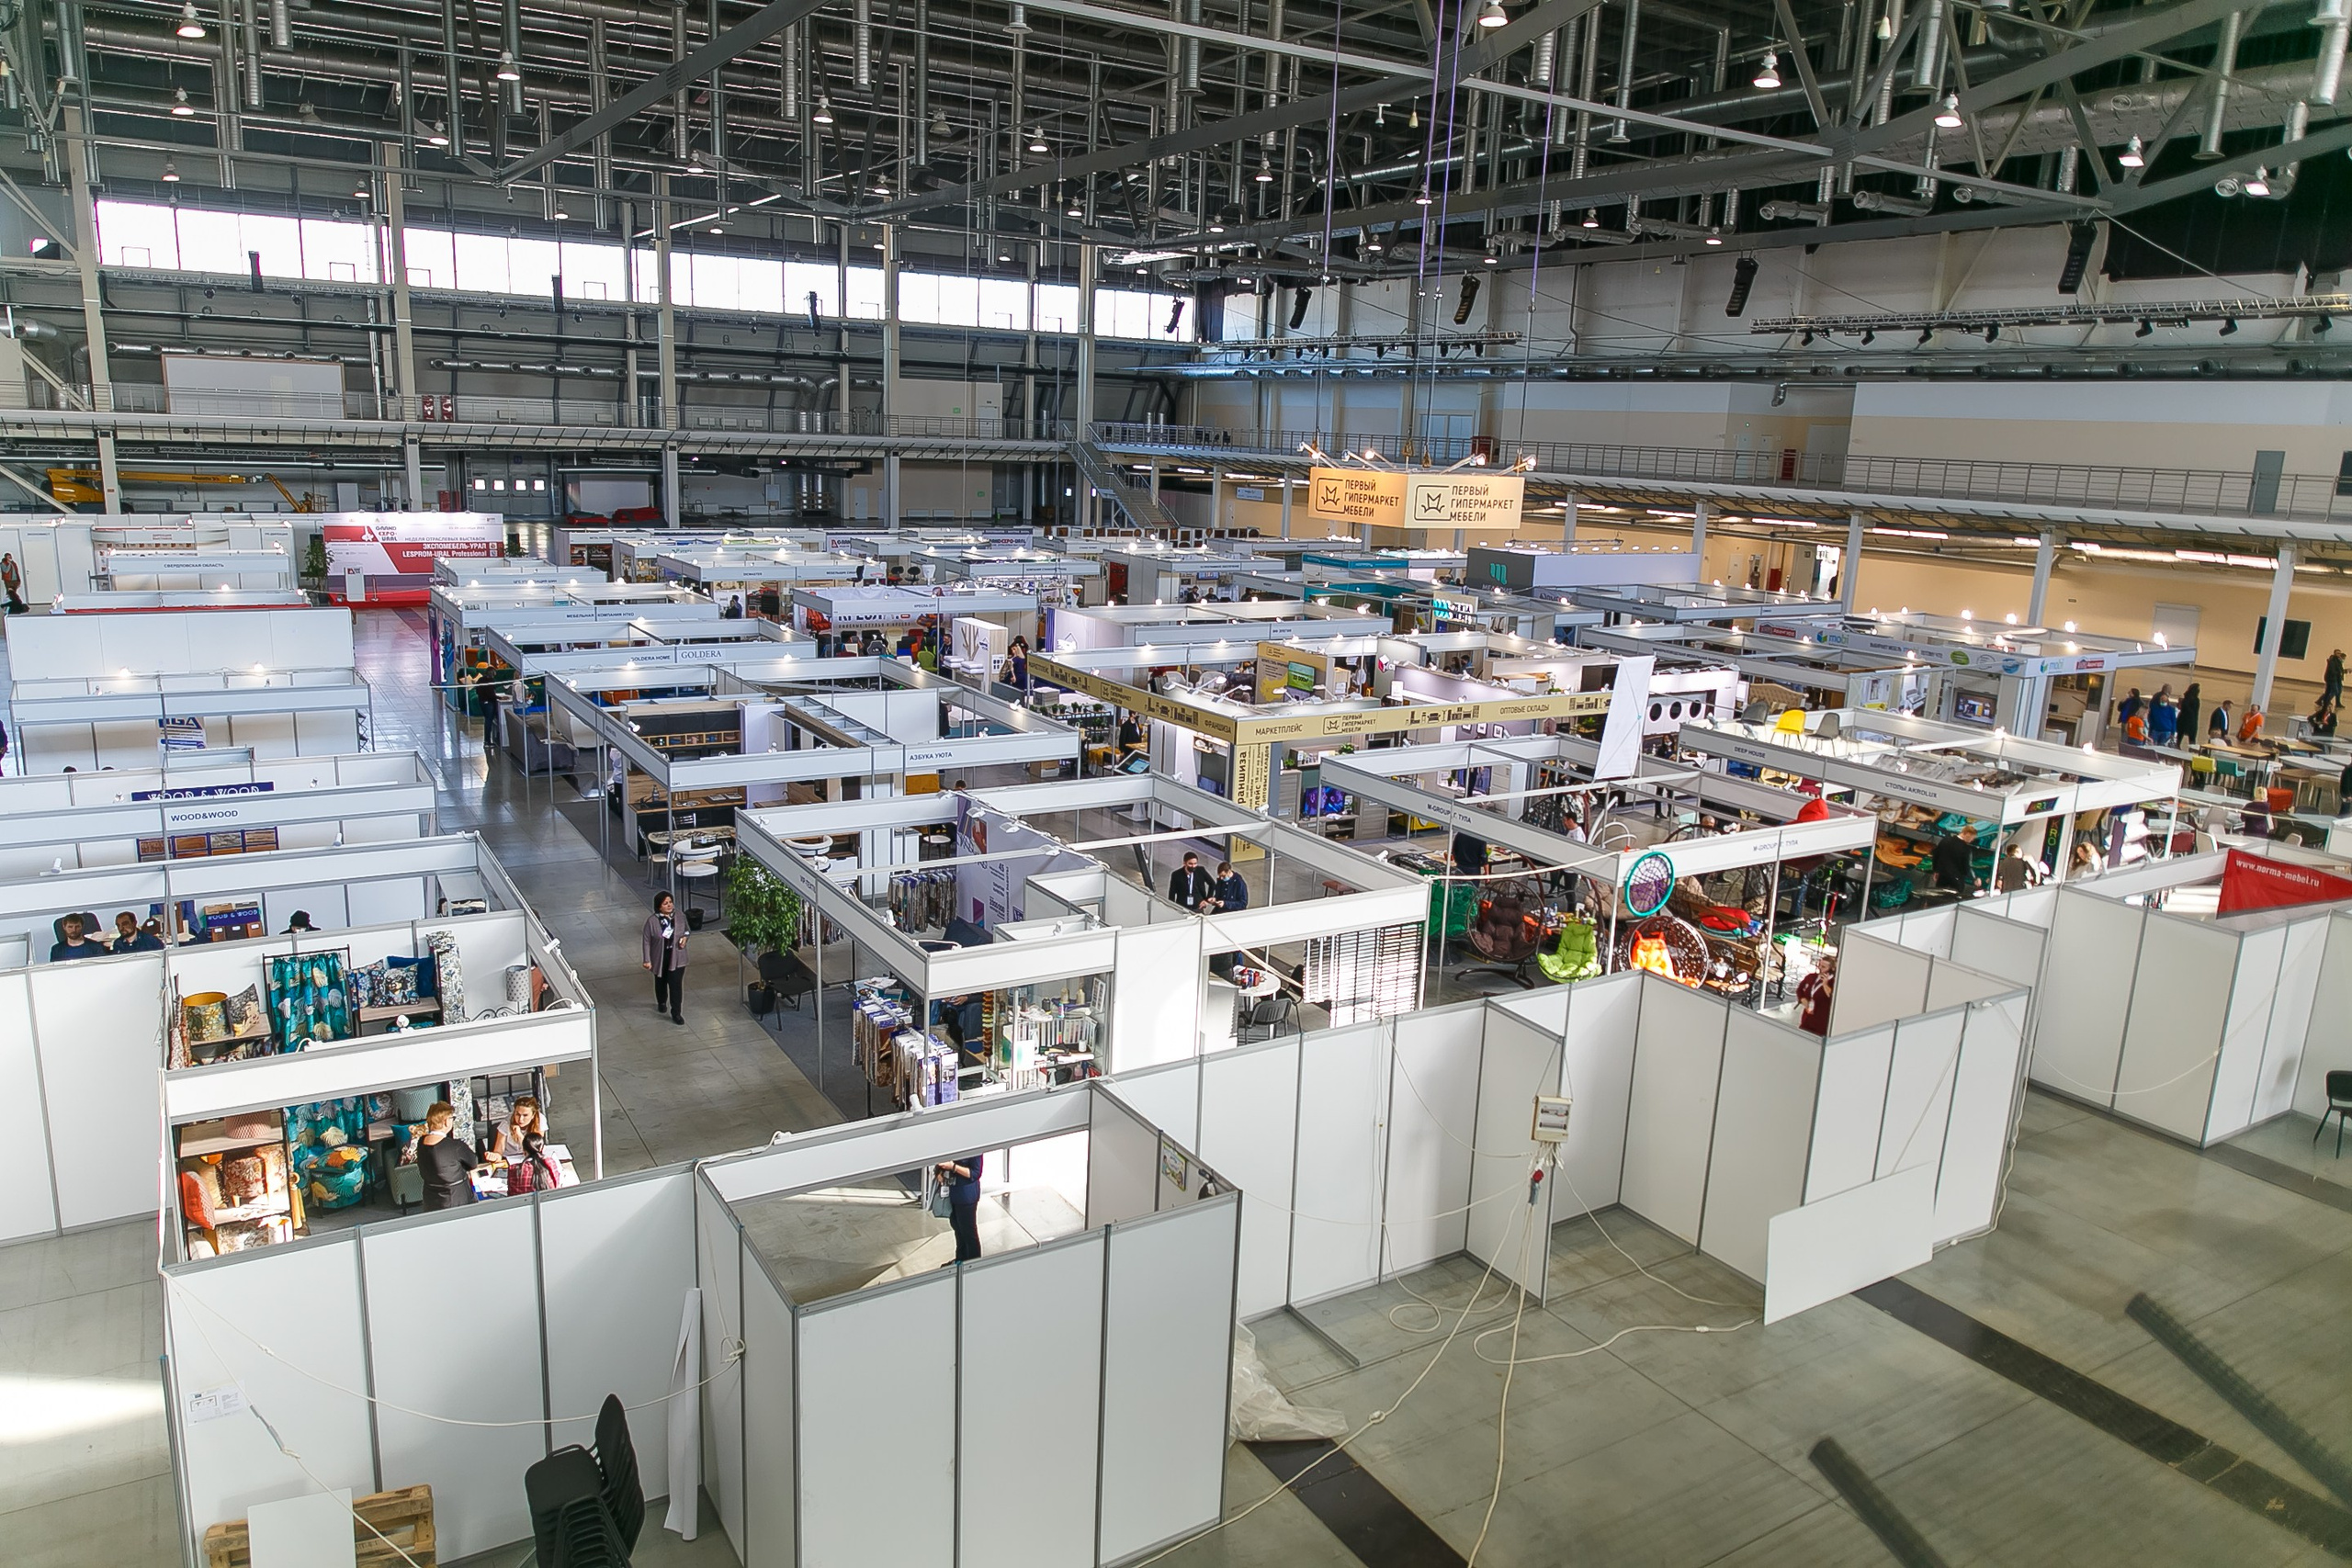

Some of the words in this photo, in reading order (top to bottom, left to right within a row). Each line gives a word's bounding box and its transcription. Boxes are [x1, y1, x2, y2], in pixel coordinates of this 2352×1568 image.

[1345, 479, 1376, 491] ПЕРВЫЙ
[1452, 484, 1488, 495] ПЕРВЫЙ
[1344, 492, 1399, 506] ГИПЕРМАРКЕТ
[1451, 499, 1513, 510] ГИПЕРМАРКЕТ
[1344, 505, 1374, 517] МЕБЕЛИ
[1450, 512, 1486, 522] МЕБЕЛИ
[1828, 634, 1849, 644] mobi
[681, 650, 722, 659] GOLDERA
[1499, 705, 1525, 715] ОПТОВЫЕ
[1526, 704, 1550, 712] СКЛАДЫ
[1341, 718, 1376, 727] ГИПЕРМАРКЕТ
[1342, 713, 1363, 721] ПЕРВЫЙ
[1204, 719, 1231, 734] ФРАНШИЗА
[1255, 723, 1303, 736] МАРКЕТПЛЕЙС
[1734, 746, 1747, 754] DEEP
[1747, 749, 1766, 759] HOUSE
[1885, 782, 1907, 793] СТОЛЫ
[1907, 785, 1938, 798] AKROLUX
[171, 809, 239, 822] WOOD&WOOD
[1427, 803, 1451, 816] M-GROUP
[1458, 814, 1471, 823] ТУЛА
[1753, 842, 1778, 852] M-GROUP
[2235, 859, 2320, 887] www.norma-mebel.ru
